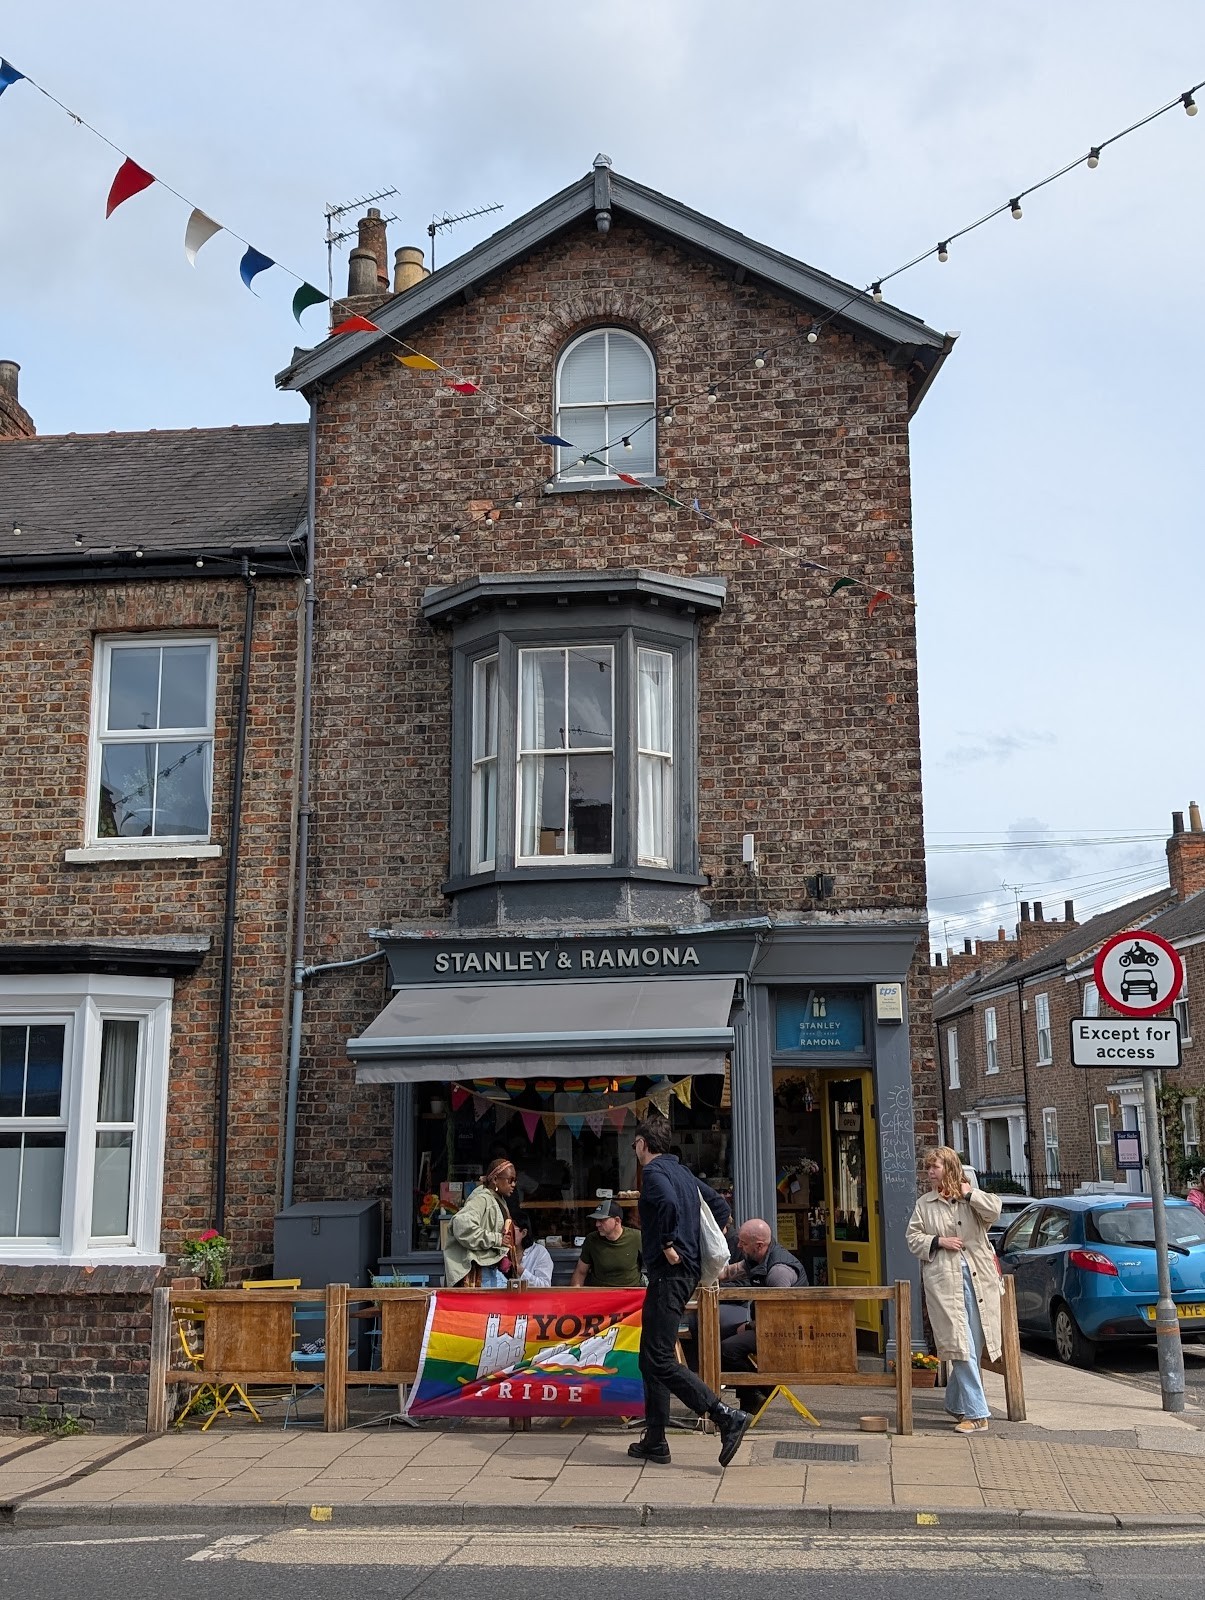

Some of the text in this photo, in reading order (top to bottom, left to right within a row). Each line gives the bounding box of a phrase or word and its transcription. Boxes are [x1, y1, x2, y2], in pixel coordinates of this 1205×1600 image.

[435, 947, 700, 973] STANLEY & RAMONA
[880, 987, 897, 996] tps
[1080, 1026, 1171, 1042] Except for
[1097, 1047, 1155, 1059] access
[843, 1118, 856, 1127] OPEN
[881, 1113, 909, 1135] Coffee
[883, 1146, 912, 1160] Baked
[884, 1159, 906, 1170] Cake
[1181, 1305, 1202, 1317] VYE
